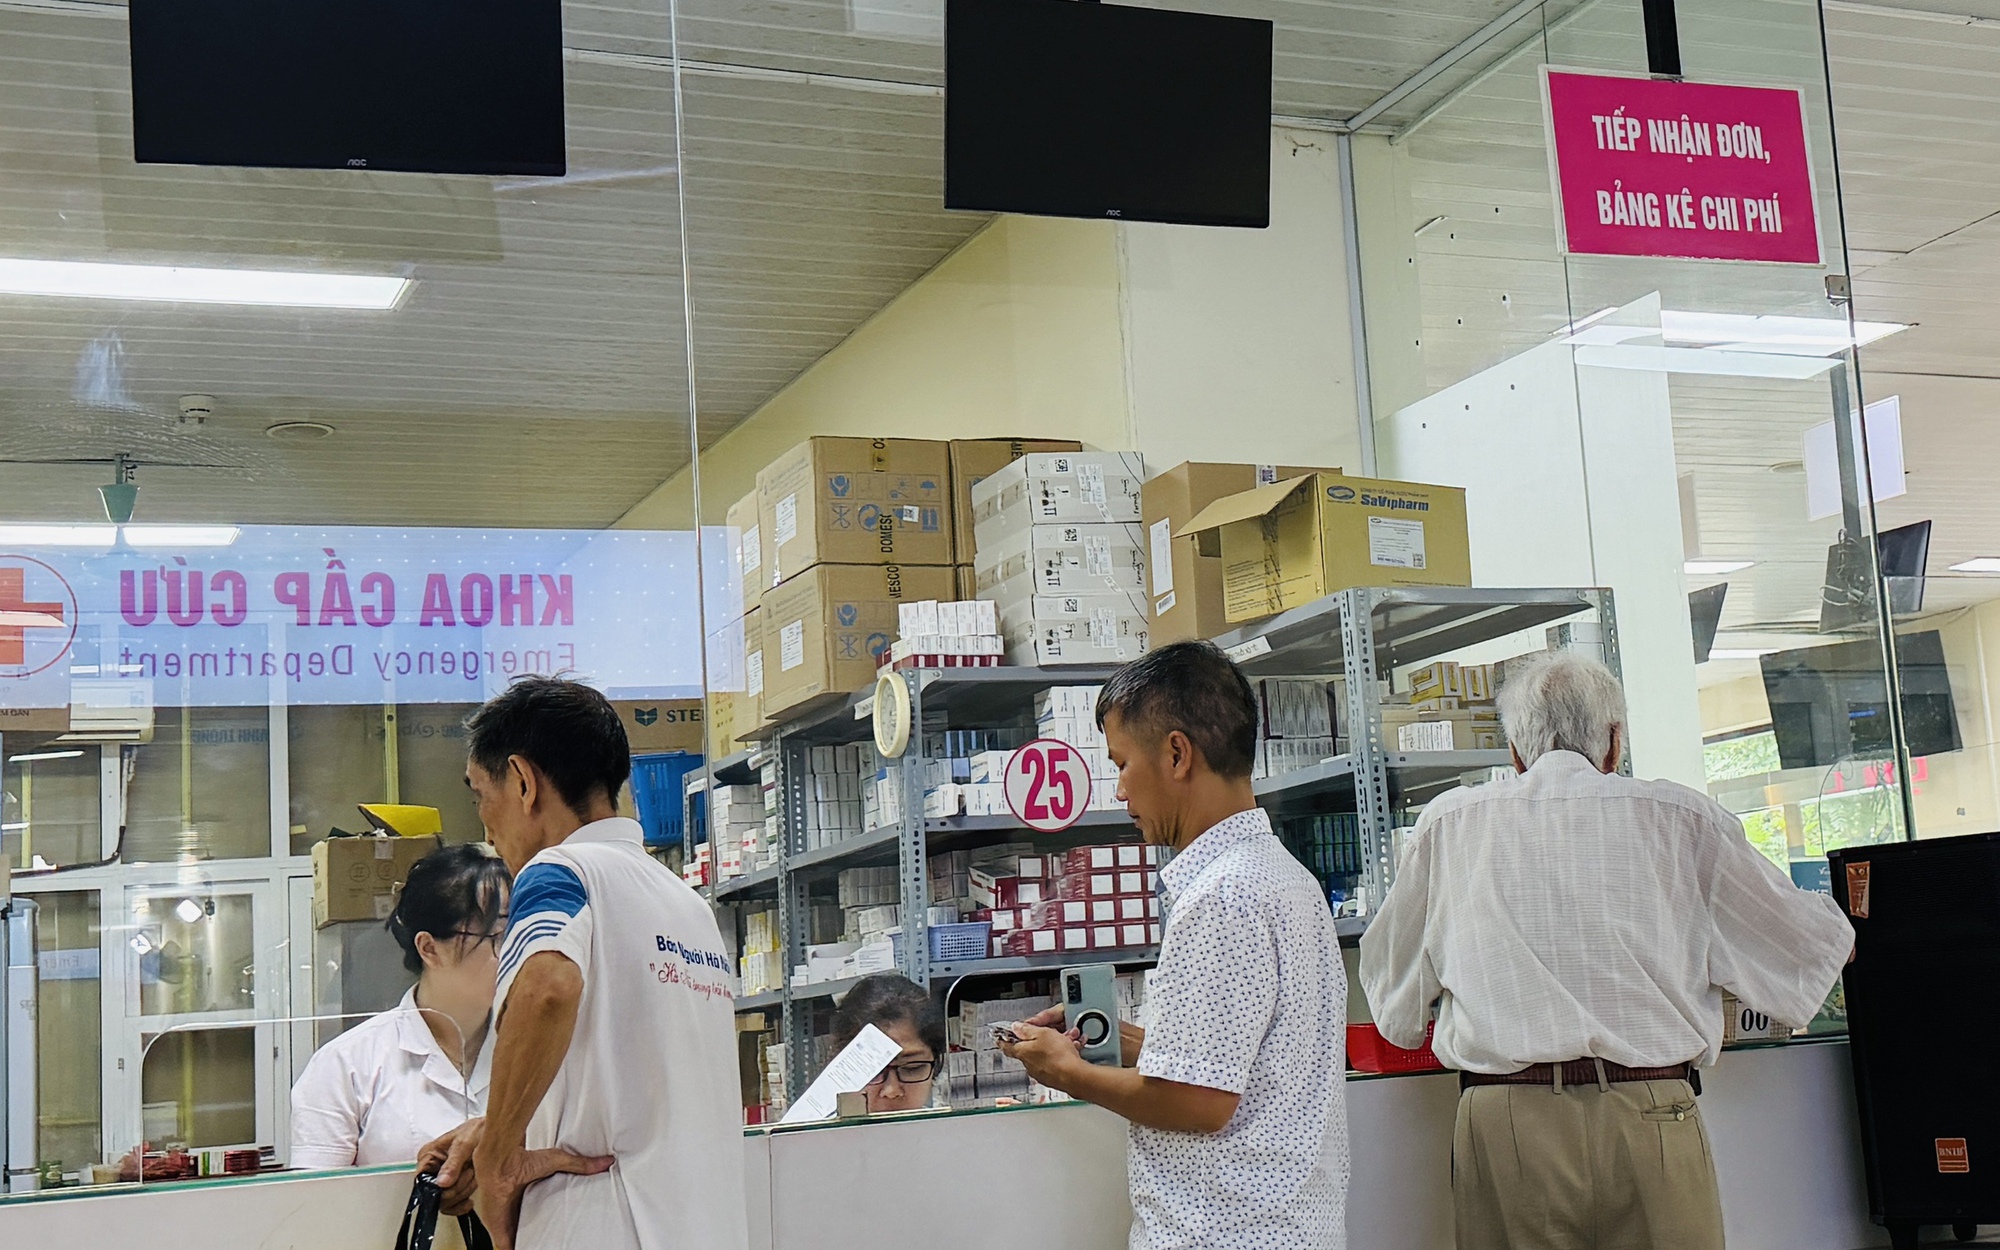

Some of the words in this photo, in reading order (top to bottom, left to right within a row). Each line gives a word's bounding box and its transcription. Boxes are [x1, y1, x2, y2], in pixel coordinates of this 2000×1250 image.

[1592, 105, 1642, 151] TIẾP
[1647, 113, 1713, 163] NHẬN
[1715, 121, 1771, 164] ĐƠN,
[1596, 179, 1662, 228] BẢNG
[1665, 187, 1697, 229] KÊ
[1701, 195, 1740, 231] CHI
[1743, 192, 1783, 233] PHÍ
[1021, 748, 1073, 820] 25
